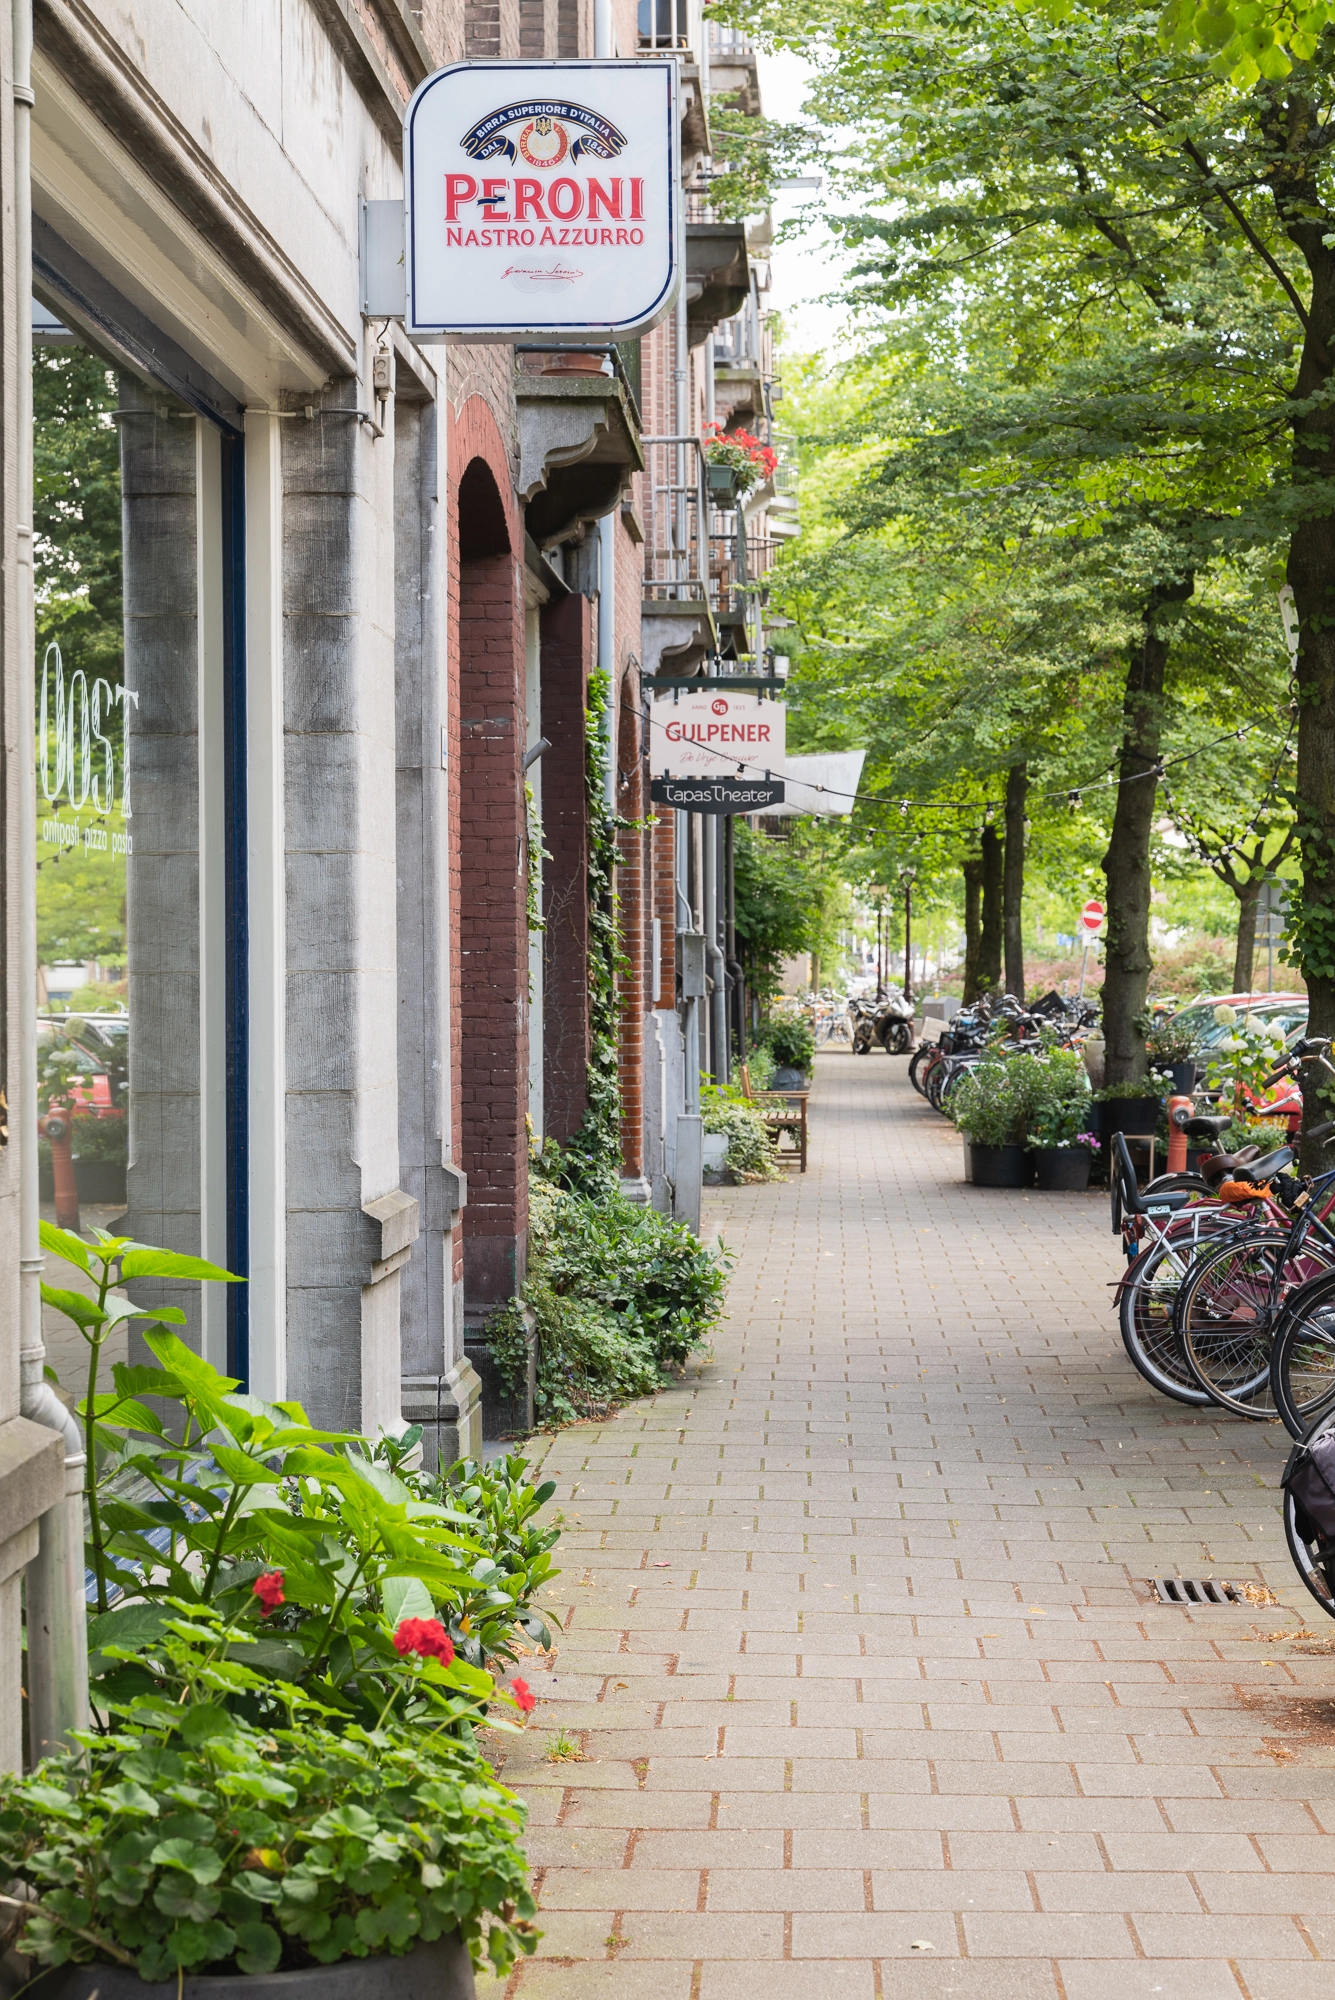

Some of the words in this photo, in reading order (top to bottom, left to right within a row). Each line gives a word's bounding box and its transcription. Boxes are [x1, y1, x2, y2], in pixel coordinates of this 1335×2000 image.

[475, 114, 508, 139] BIRRA
[507, 104, 568, 119] SUPERIORE
[569, 108, 611, 137] D'ITALIA
[481, 141, 501, 158] DAL
[520, 128, 532, 158] BIRRA
[586, 138, 609, 158] 1846
[532, 158, 556, 167] 1846
[443, 173, 647, 224] PERONI
[446, 227, 536, 248] NASTRO
[539, 226, 645, 247] AZZURRO
[39, 641, 140, 819] OOST
[665, 721, 771, 743] GULPENER
[43, 812, 80, 854] antipasti
[84, 818, 108, 858] pizza
[112, 828, 133, 862] pasta
